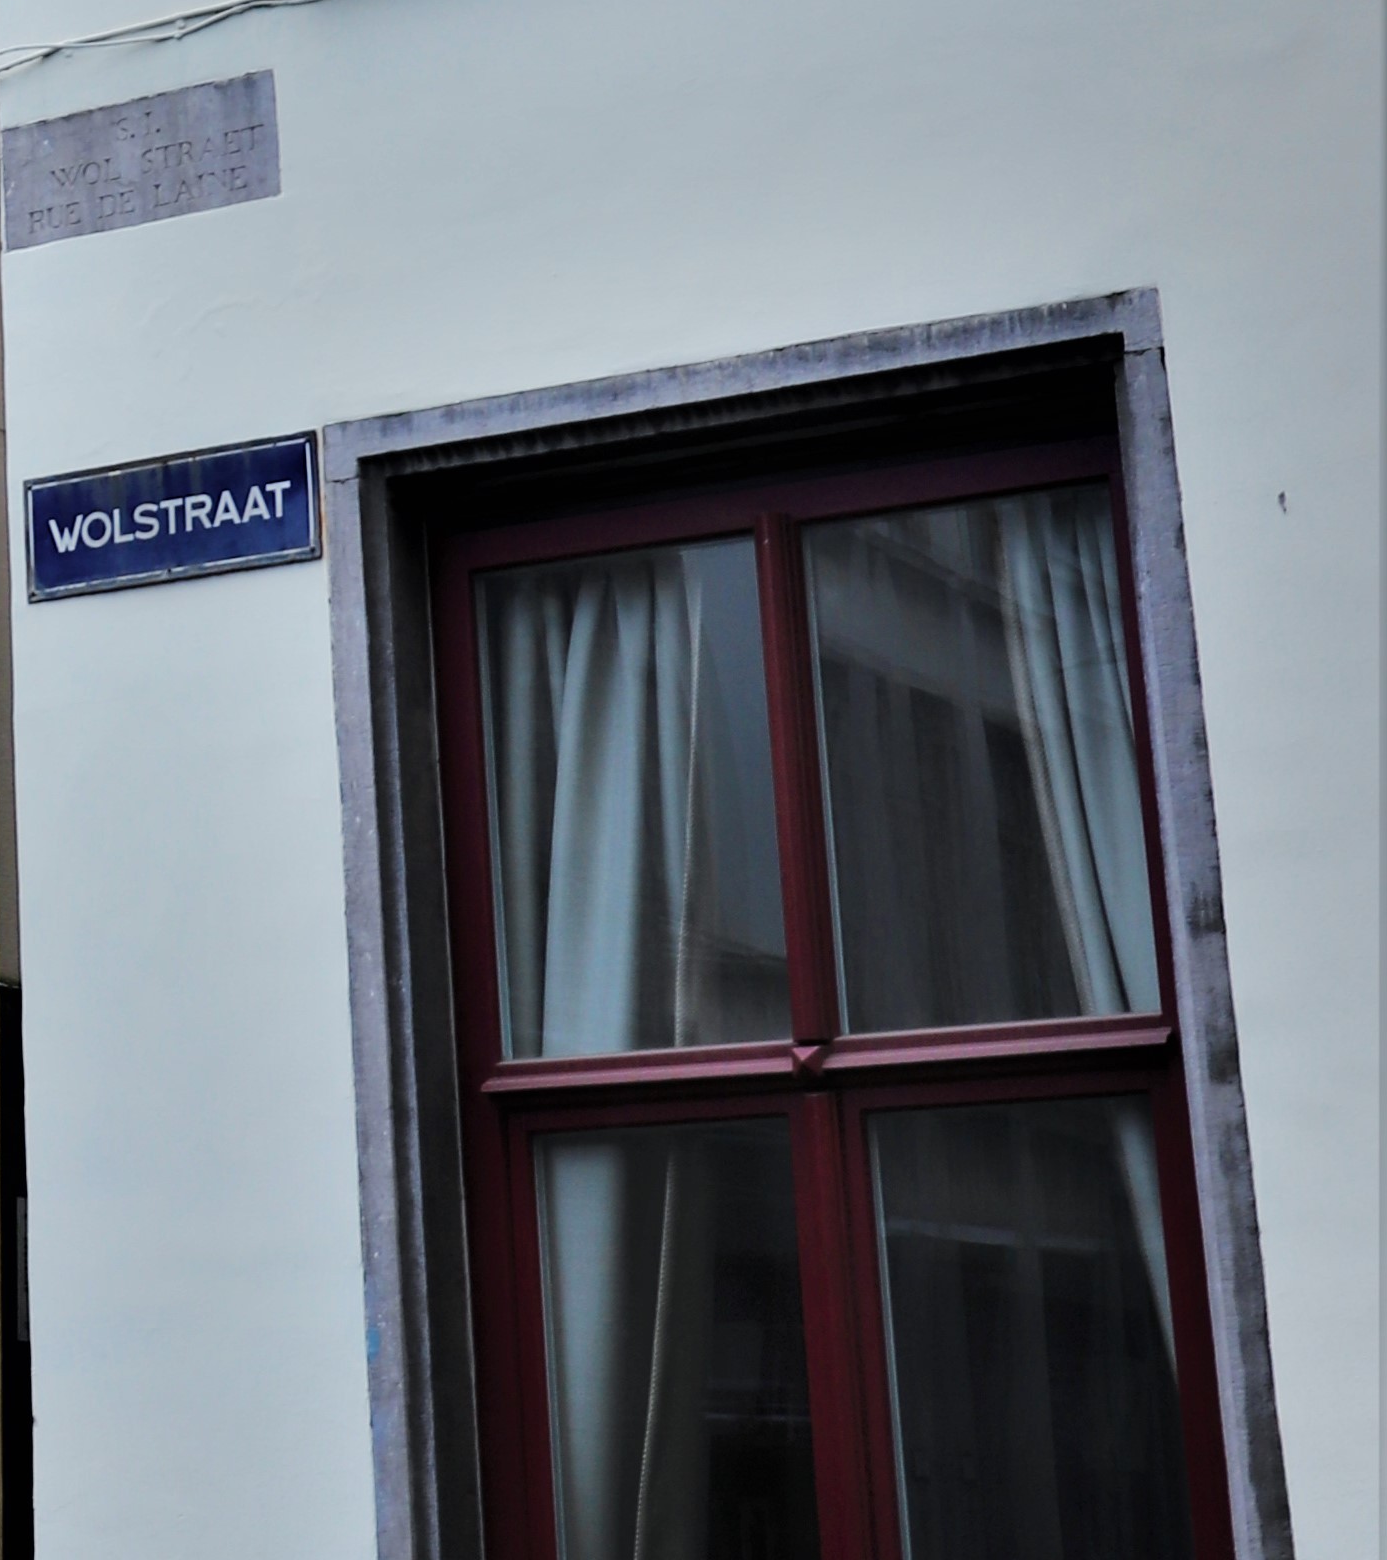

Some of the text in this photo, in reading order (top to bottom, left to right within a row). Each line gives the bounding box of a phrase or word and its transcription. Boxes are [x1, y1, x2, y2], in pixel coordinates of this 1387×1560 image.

[50, 123, 264, 188] WOL STRAET
[28, 165, 248, 234] RUE DE LAINE
[48, 480, 292, 554] WOLSTRAAT
